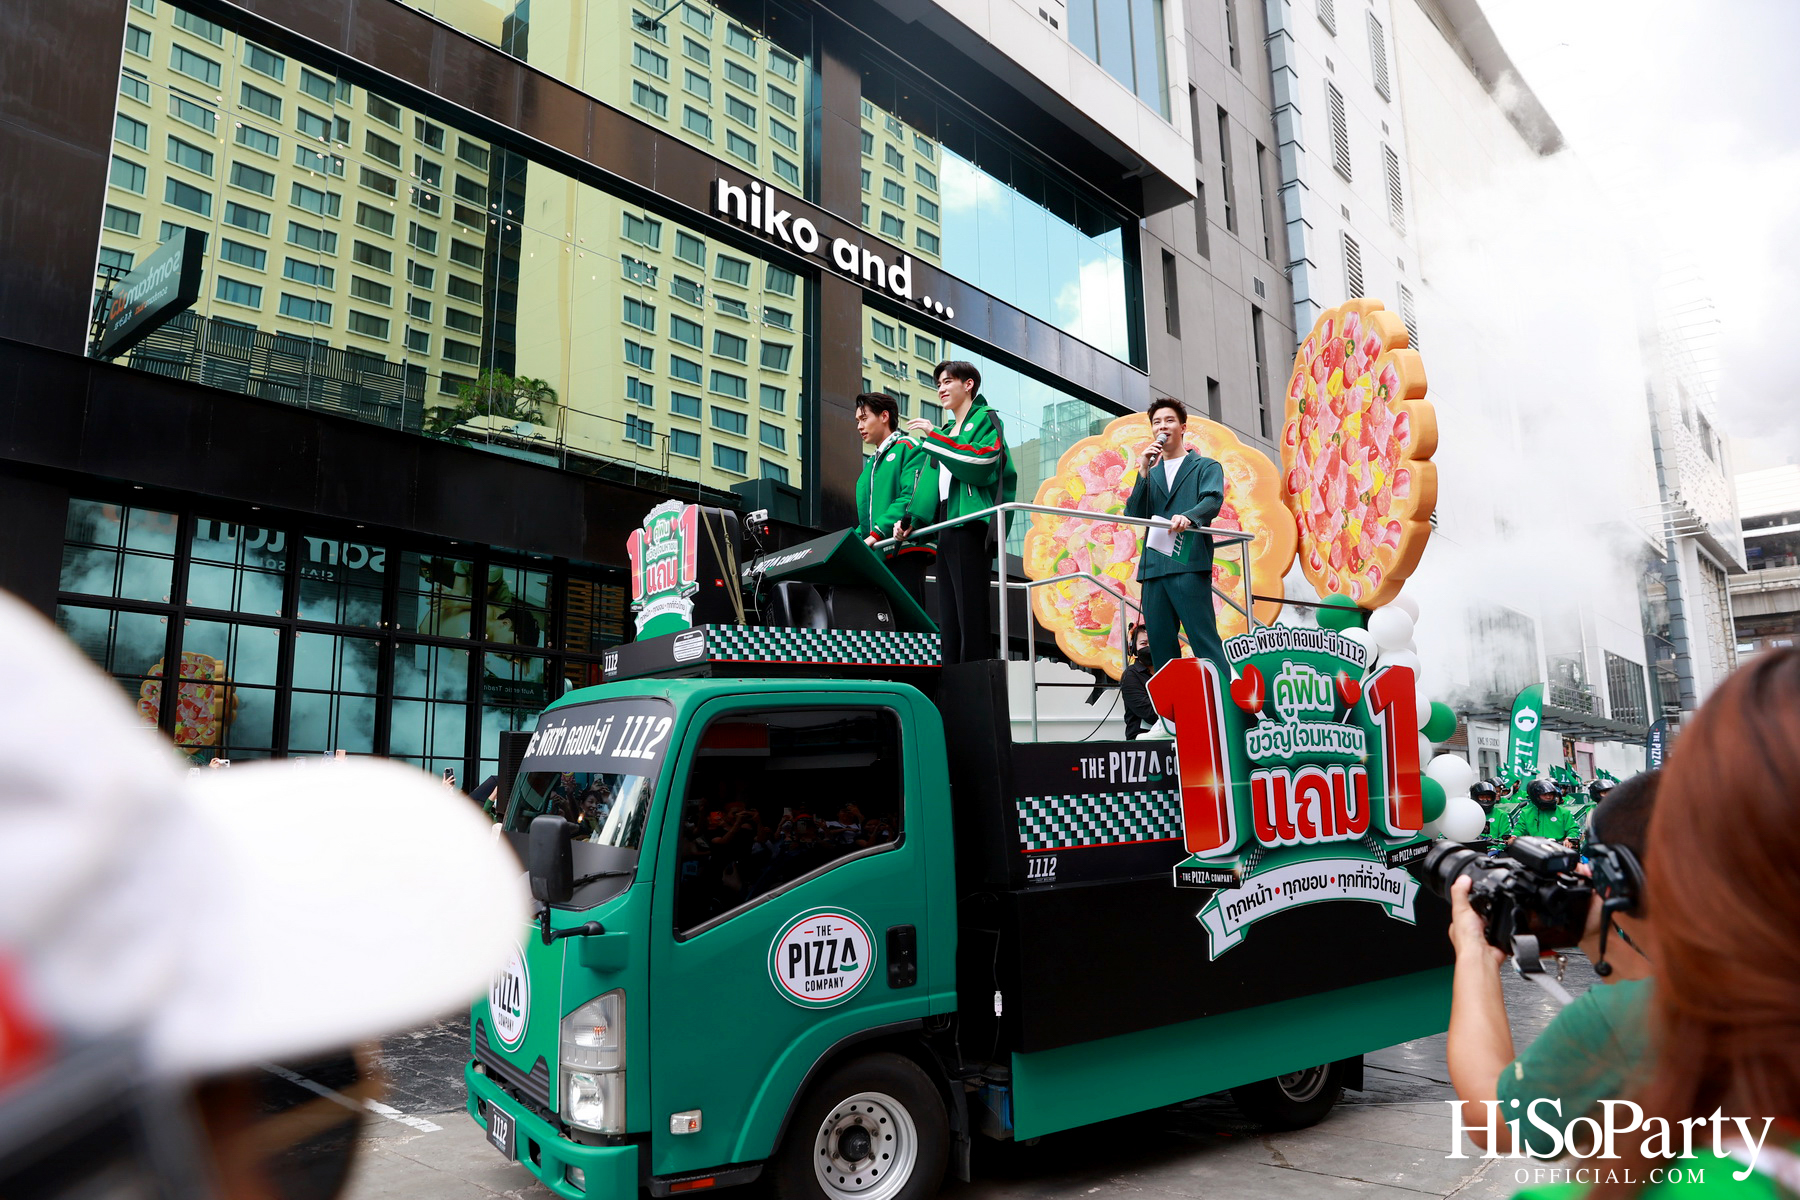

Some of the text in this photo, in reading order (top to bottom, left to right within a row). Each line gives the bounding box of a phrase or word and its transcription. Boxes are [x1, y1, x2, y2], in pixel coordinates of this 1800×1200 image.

[717, 177, 819, 253] niko
[832, 237, 913, 299] and
[647, 558, 678, 593] แถม
[1228, 627, 1366, 665] เดอะ พิซซ่า คอมปะนี 1112
[604, 654, 619, 673] 1112
[1276, 666, 1332, 718] คู่ฟิน
[610, 715, 673, 760] 1112
[1249, 721, 1363, 755] ขวัญใจมหาชน
[1651, 743, 1662, 766] PIZZA
[1080, 757, 1106, 779] THE
[1108, 750, 1163, 784] PIZZA
[1147, 657, 1424, 854] 1 แถม 1
[1027, 857, 1057, 879] 1112
[1398, 848, 1414, 863] PIZZA
[1182, 870, 1233, 884] THE PIZZA COMPANY
[1226, 864, 1401, 923] ทุกหน้า ทุกขอบ ทุกที่ทั่วไทย
[816, 925, 832, 937] THE
[788, 937, 859, 979] PIZZA
[805, 977, 844, 992] COMPANY
[492, 1113, 508, 1146] 1112
